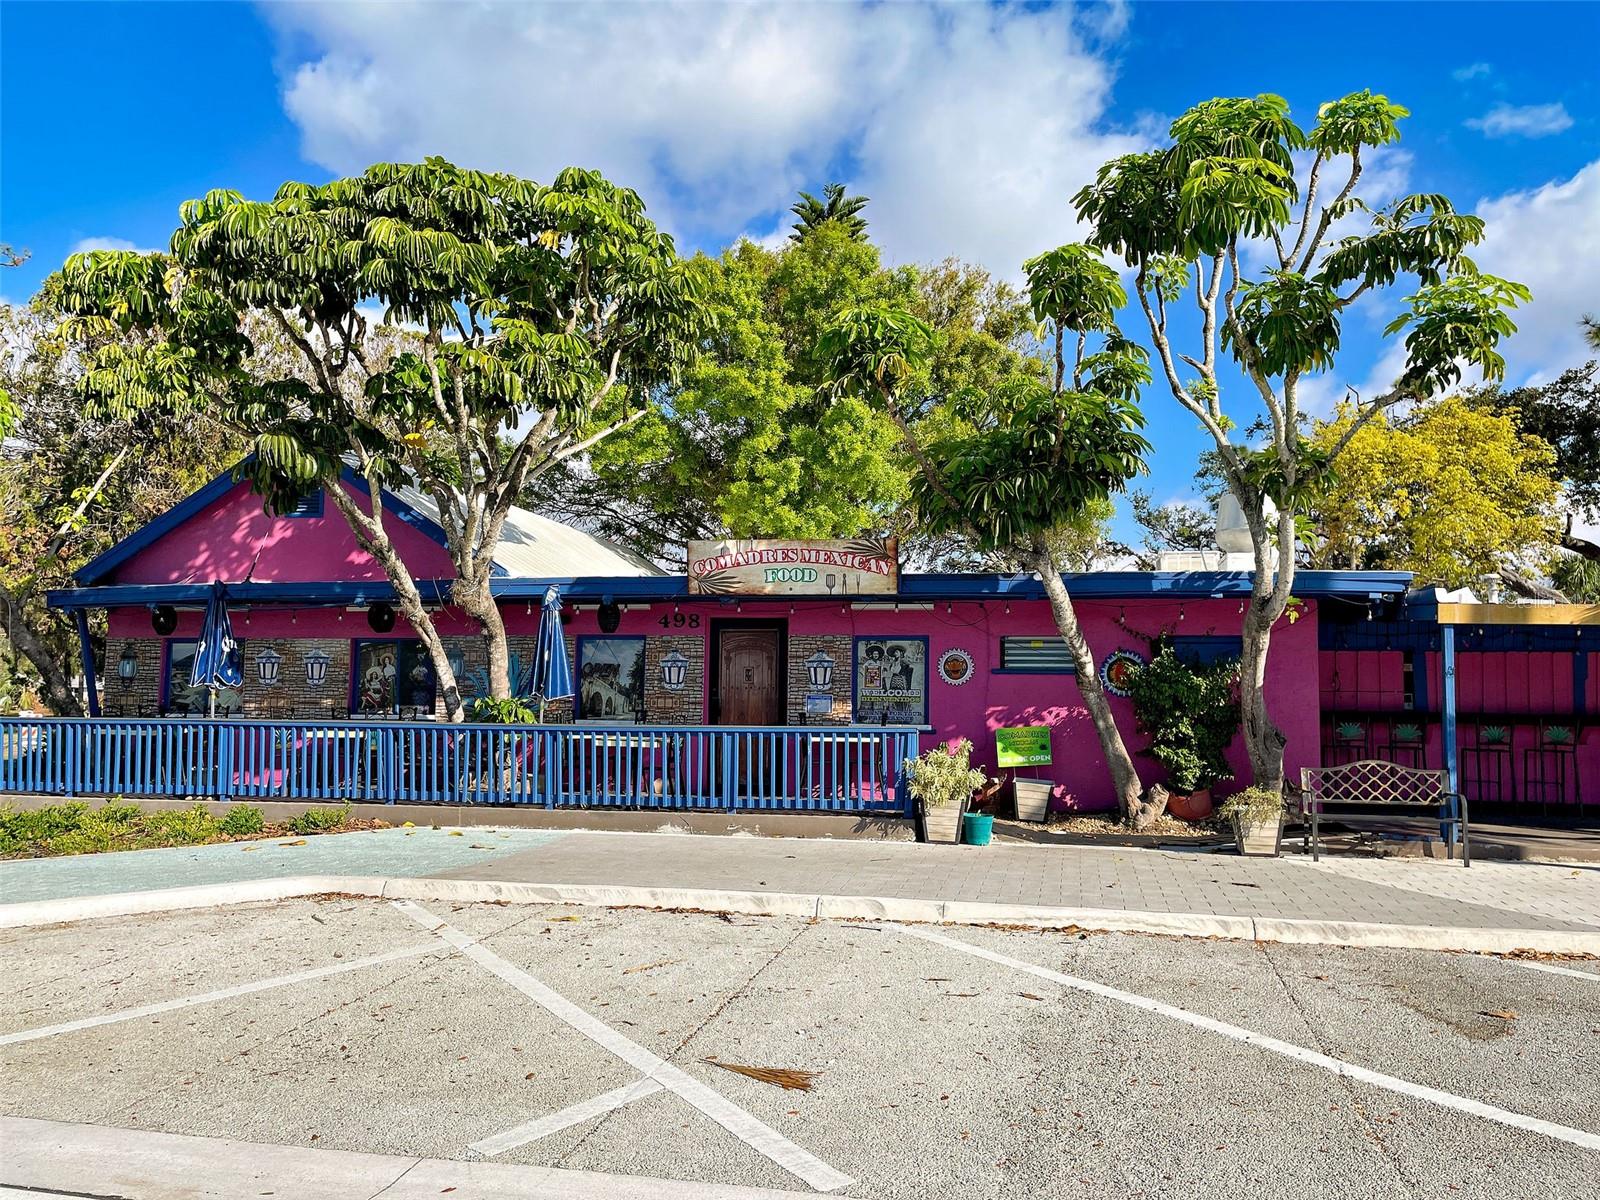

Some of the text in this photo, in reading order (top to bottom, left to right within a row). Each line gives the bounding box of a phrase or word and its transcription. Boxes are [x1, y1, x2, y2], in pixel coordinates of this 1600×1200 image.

[693, 548, 893, 576] COMADRES MEXICAN
[765, 567, 818, 583] FOOD
[657, 612, 700, 628] 498
[861, 689, 921, 697] WELCOME
